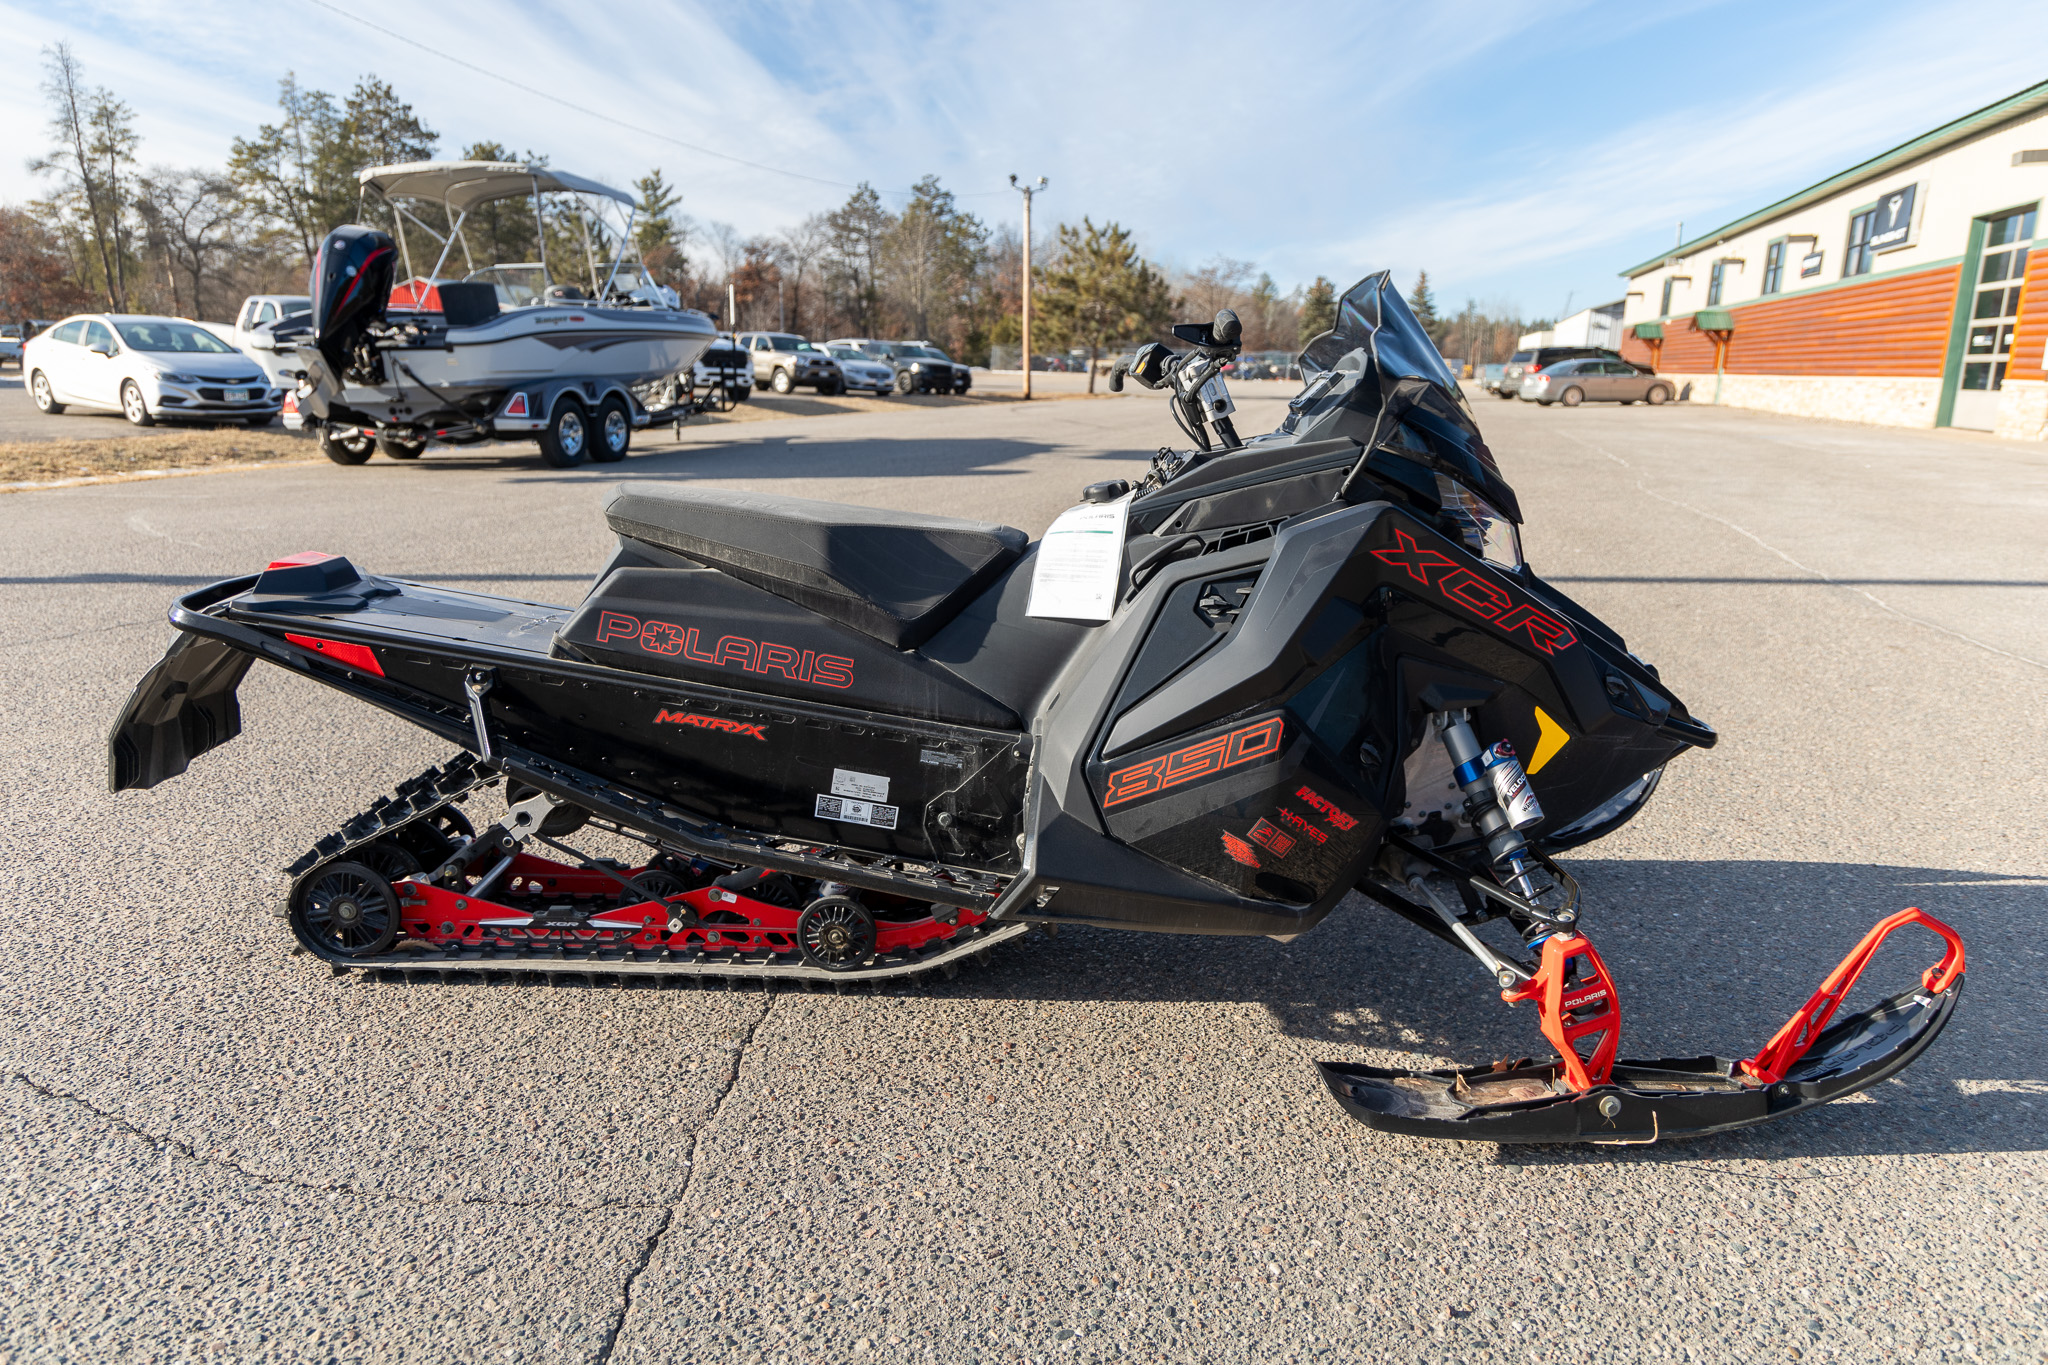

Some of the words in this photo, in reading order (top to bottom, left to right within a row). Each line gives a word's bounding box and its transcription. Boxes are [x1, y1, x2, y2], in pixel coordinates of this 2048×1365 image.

[1370, 528, 1578, 656] XCR
[596, 610, 854, 689] POLARIS
[652, 708, 768, 741] MATRYX
[1103, 716, 1285, 809] 850
[1276, 806, 1328, 844] HAYES
[1295, 785, 1359, 829] FACTORY
[1564, 989, 1607, 1008] POLARIS
[1800, 1022, 1905, 1078] POLARIS
